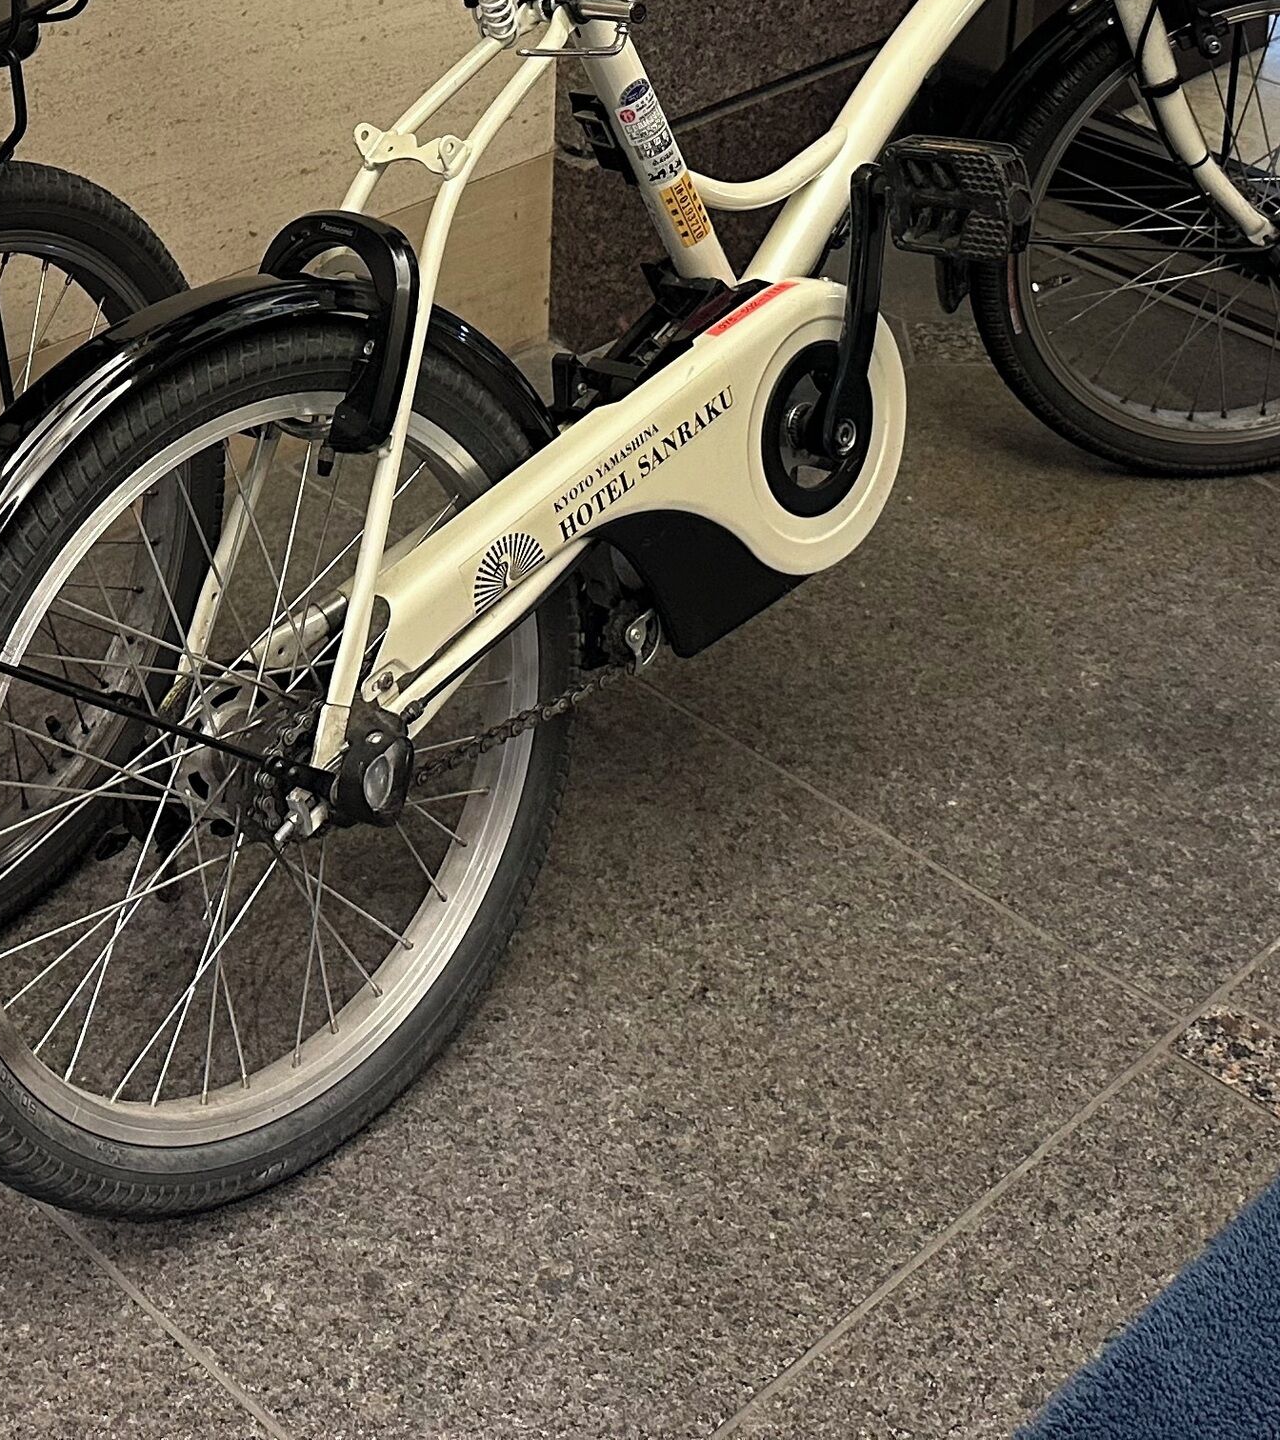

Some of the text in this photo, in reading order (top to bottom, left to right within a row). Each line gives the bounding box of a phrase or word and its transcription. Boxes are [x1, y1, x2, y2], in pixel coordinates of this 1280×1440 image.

[553, 423, 660, 513] KYOTO YAMASHINA
[558, 385, 735, 543] HOTEL SANRAKU
